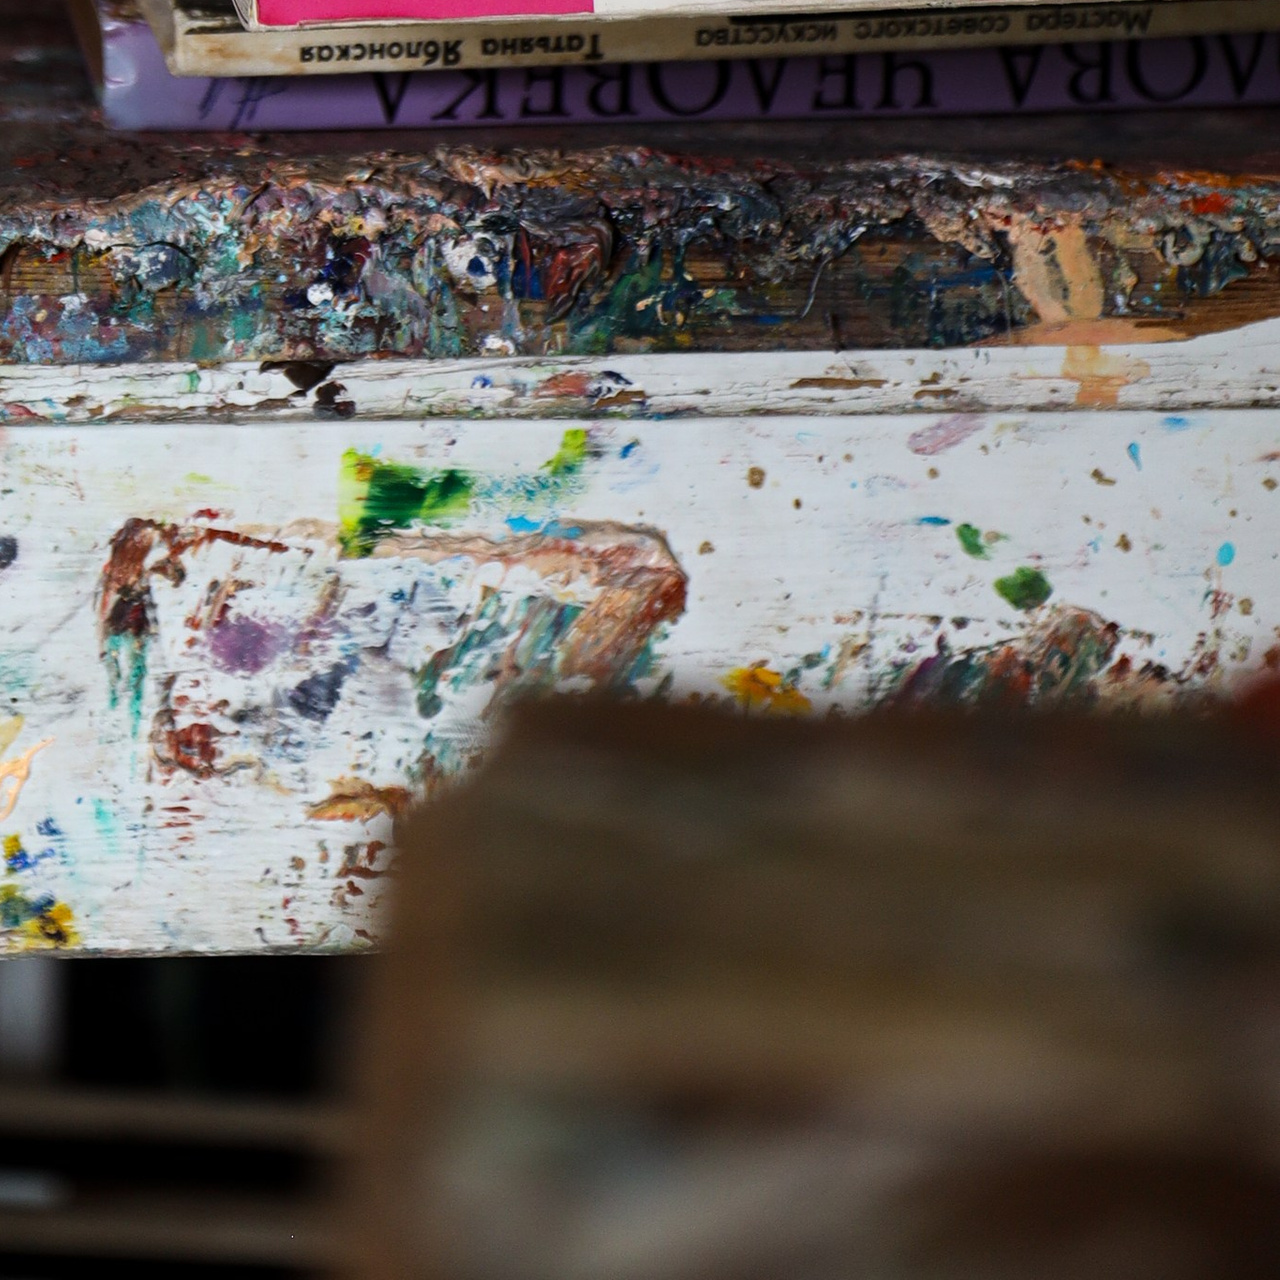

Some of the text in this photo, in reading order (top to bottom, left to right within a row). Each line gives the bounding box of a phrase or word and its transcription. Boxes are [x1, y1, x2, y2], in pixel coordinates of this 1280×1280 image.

[695, 6, 1153, 48] Мастера советского искусства
[299, 32, 604, 67] Татьяна Яблонская
[371, 52, 939, 125] ЧЕЛОВЕКА
